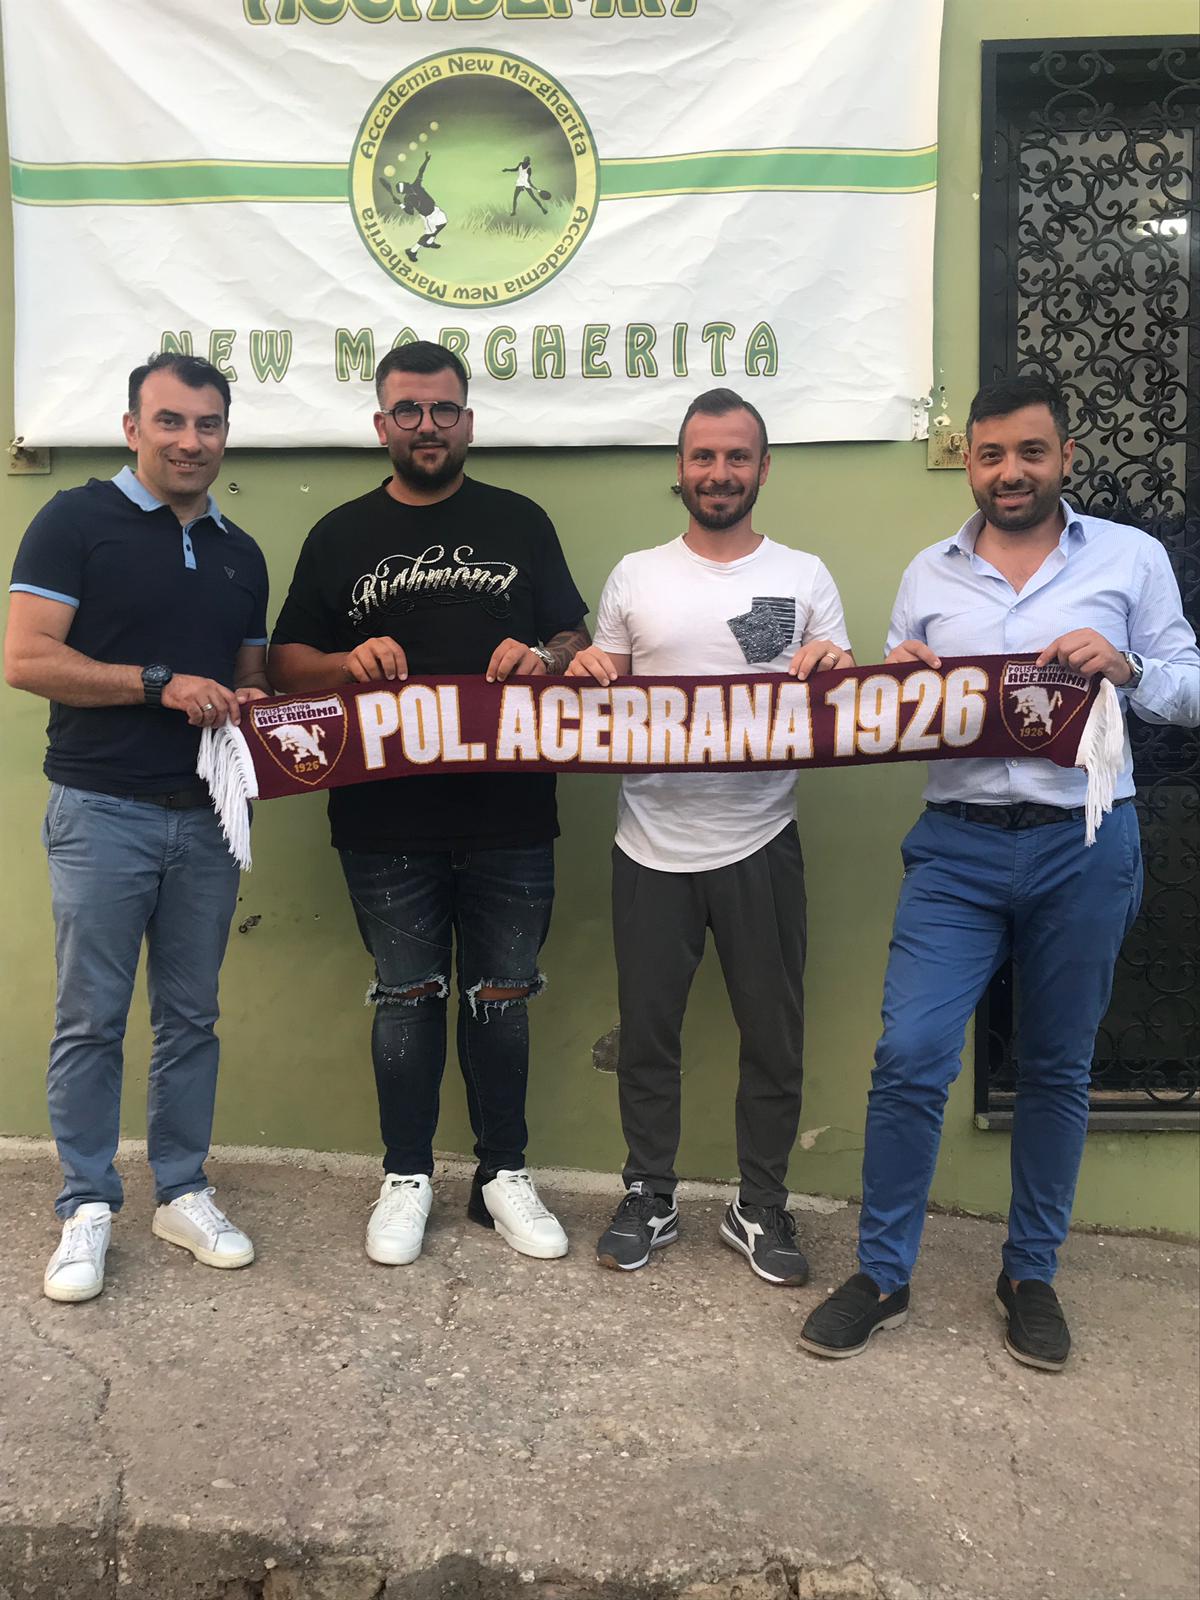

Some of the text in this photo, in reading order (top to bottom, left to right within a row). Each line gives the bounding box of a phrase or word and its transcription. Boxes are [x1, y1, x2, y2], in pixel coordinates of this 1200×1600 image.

[360, 56, 587, 160] Accademia New Margherita
[361, 205, 589, 302] Accademia New Margherita
[255, 703, 311, 718] POLISPORTIVA
[257, 705, 338, 726] ACERRANA
[354, 665, 990, 771] POL. ACERRANA 1926
[1020, 727, 1044, 738] 1926
[294, 760, 320, 773] 1926
